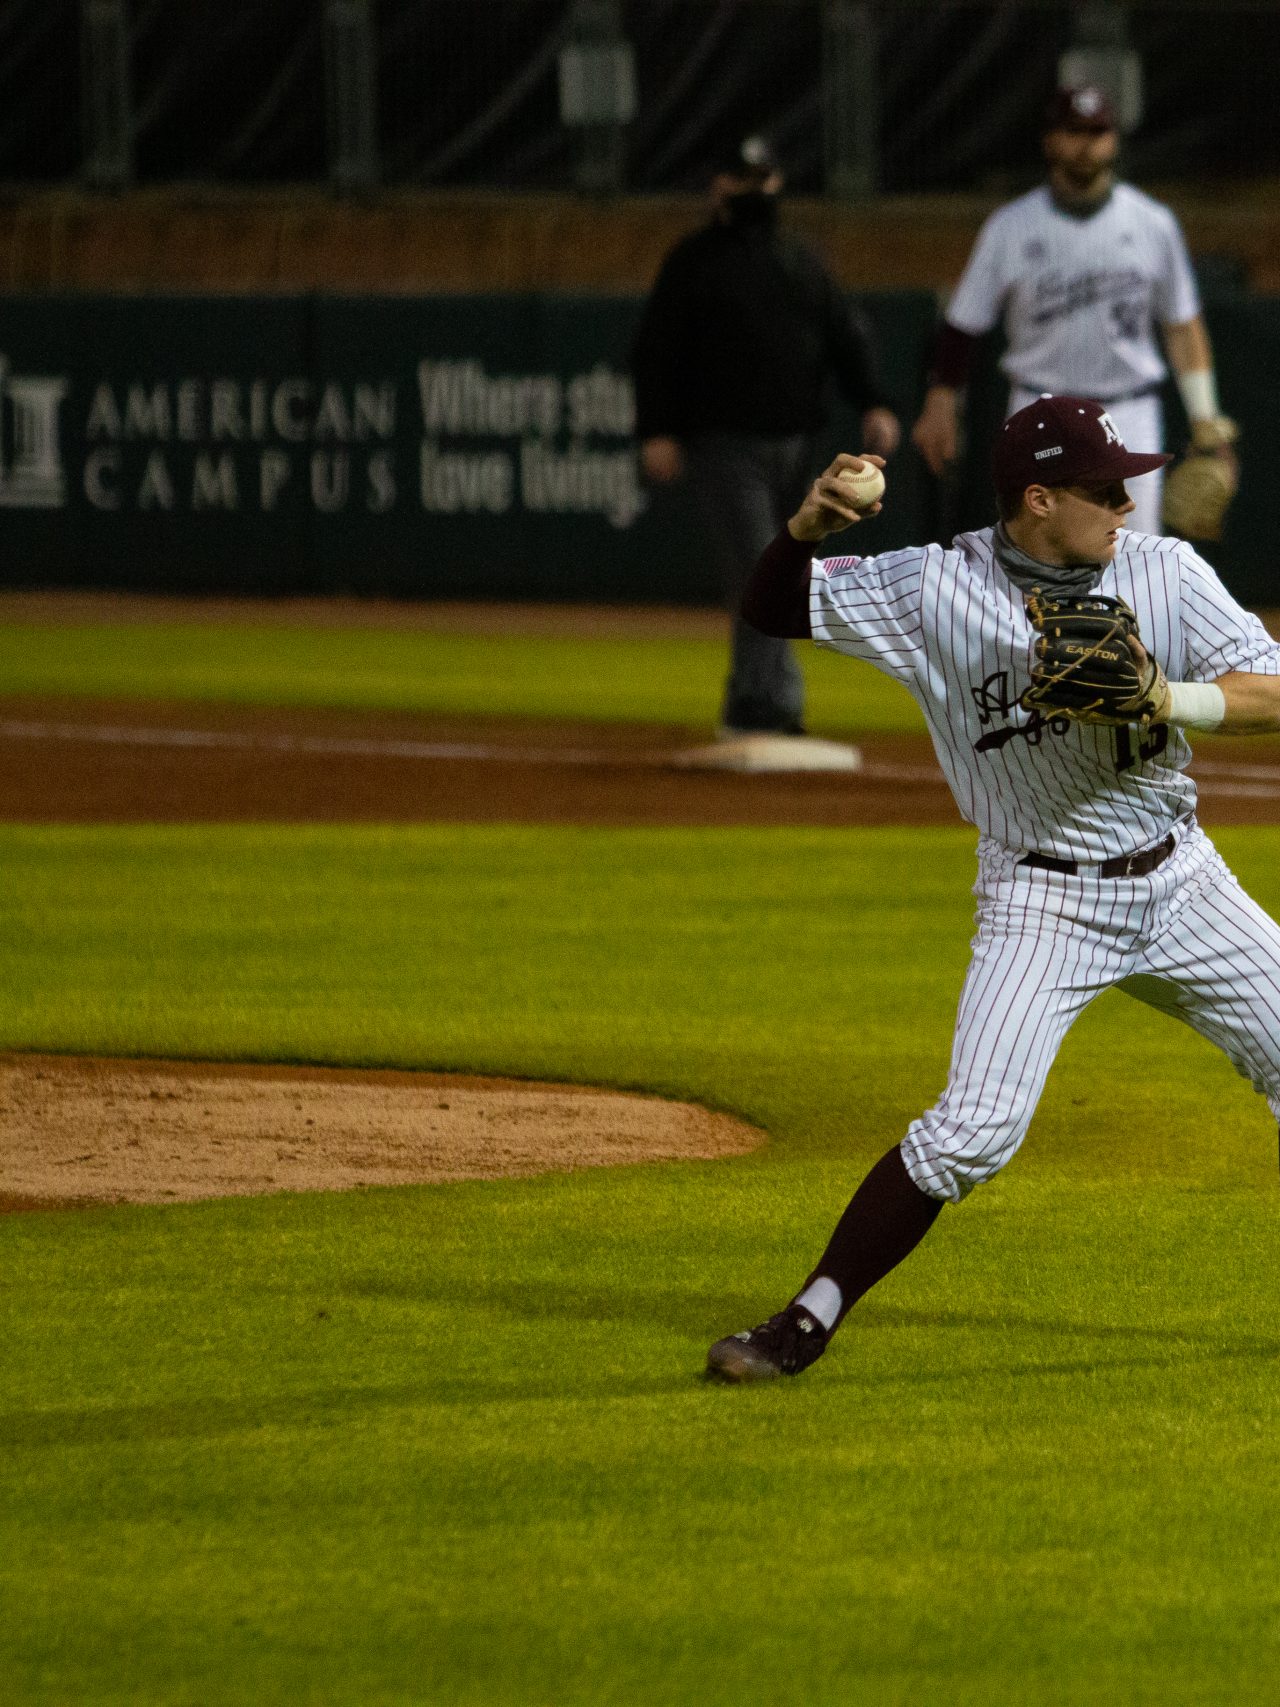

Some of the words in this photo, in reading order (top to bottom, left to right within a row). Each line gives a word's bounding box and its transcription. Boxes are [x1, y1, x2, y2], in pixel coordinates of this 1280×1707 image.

[86, 382, 396, 440] AMERICAN
[418, 358, 559, 434] Where
[84, 450, 395, 511] CAMPUS
[419, 441, 513, 512] love
[1034, 446, 1063, 460] UNIFIED
[1065, 645, 1119, 660] EASTON
